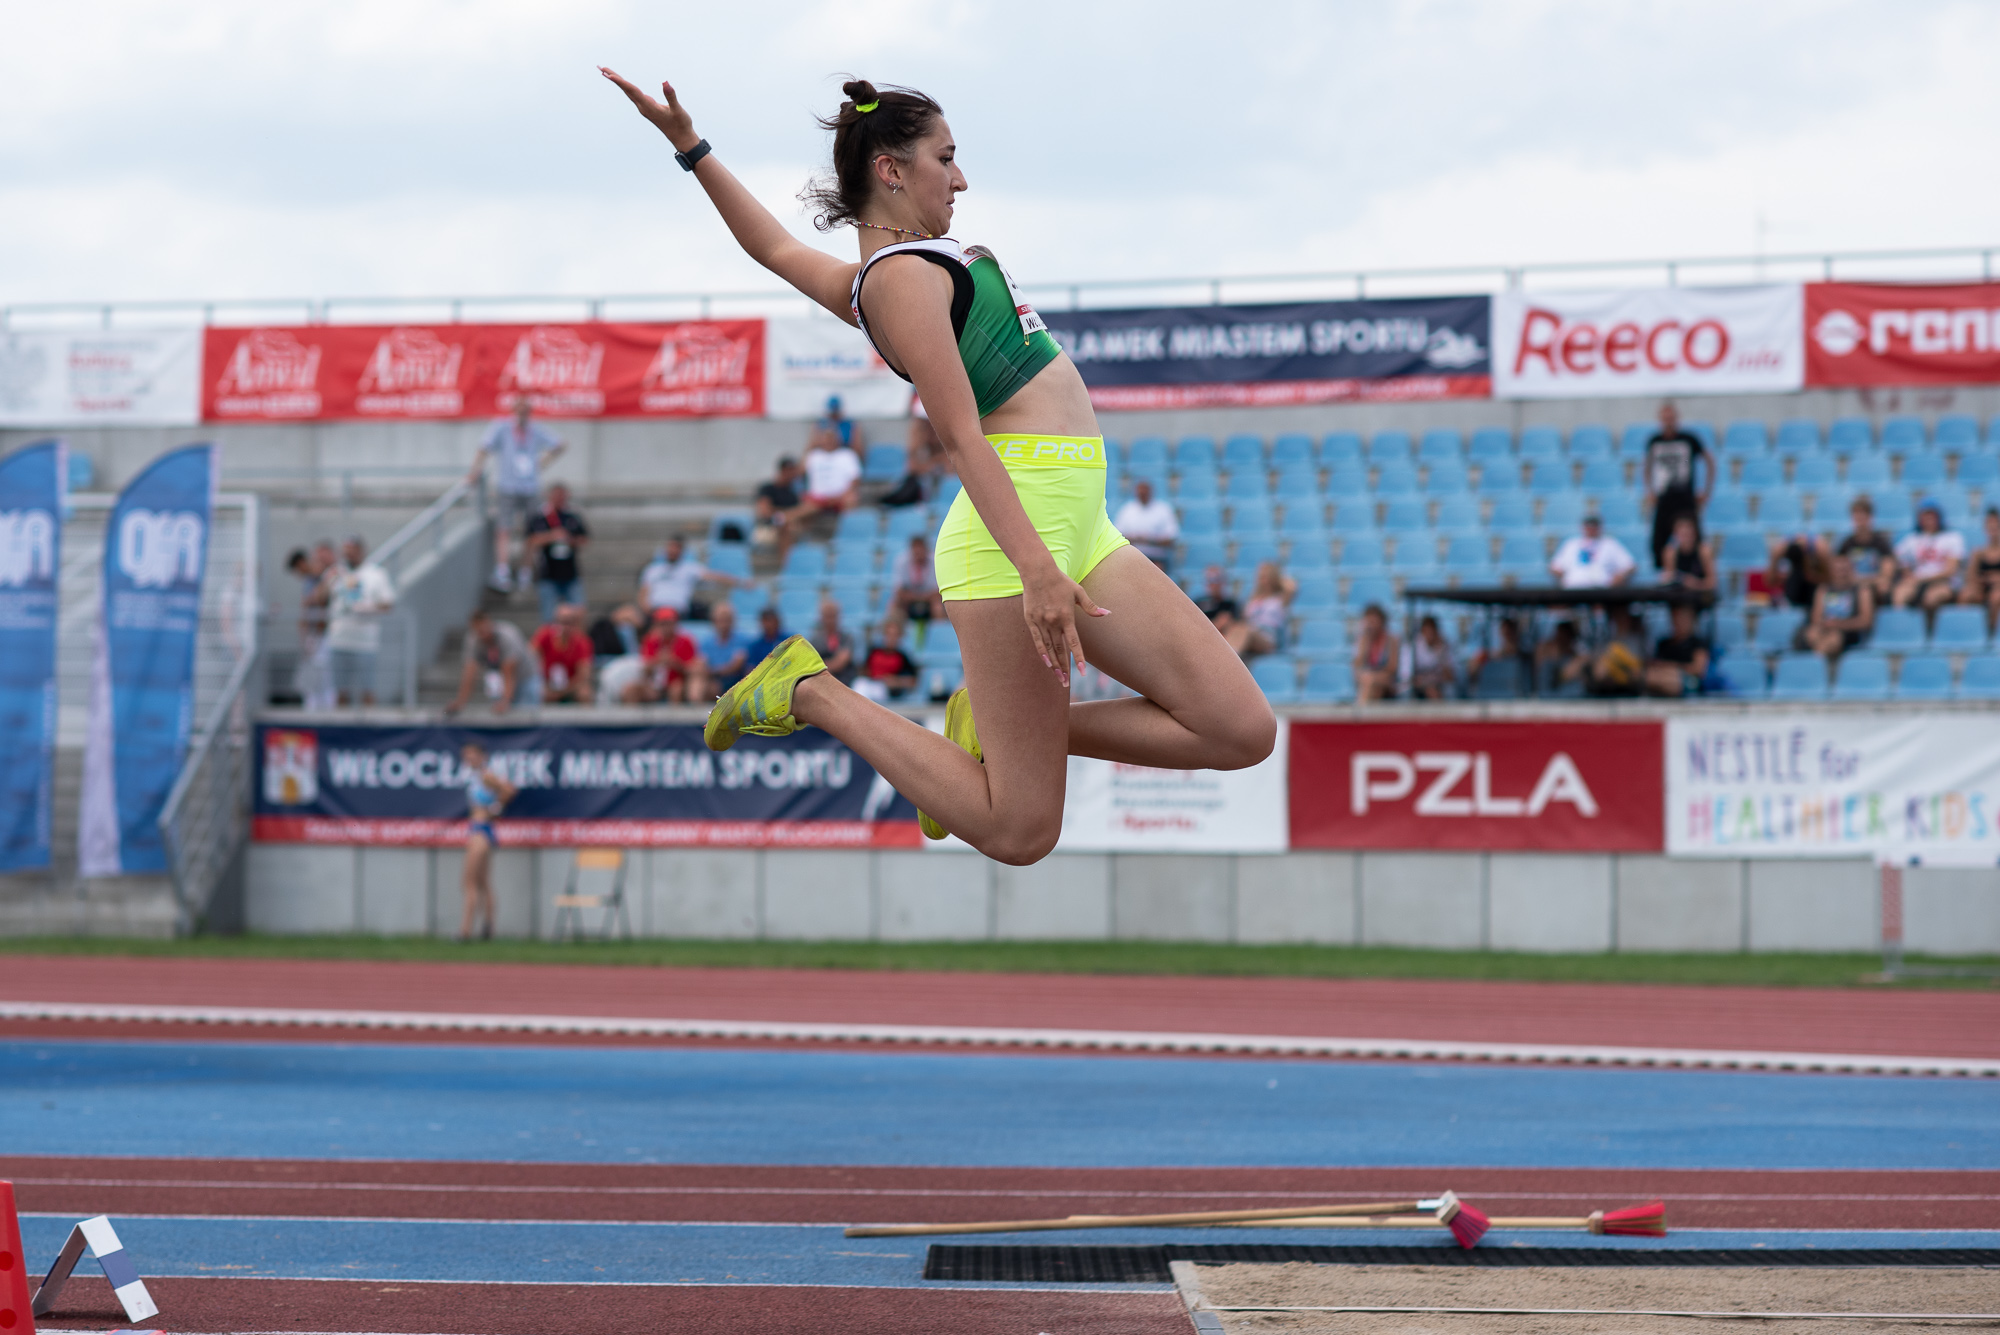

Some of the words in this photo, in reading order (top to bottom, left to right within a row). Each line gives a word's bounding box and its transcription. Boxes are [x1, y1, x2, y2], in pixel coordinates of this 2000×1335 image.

[1168, 320, 1307, 359] MIASTEM
[1309, 317, 1429, 356] SPORTU
[1512, 307, 1731, 378] Reeco
[990, 440, 1028, 458] KE
[1032, 441, 1095, 461] PRO
[558, 749, 715, 789] MIASTEM
[718, 749, 852, 790] SPORTU
[1818, 741, 1860, 783] for
[1350, 752, 1598, 816] PZLA
[1687, 792, 1889, 844] HEALTHIER
[1903, 791, 1990, 842] KIDS
